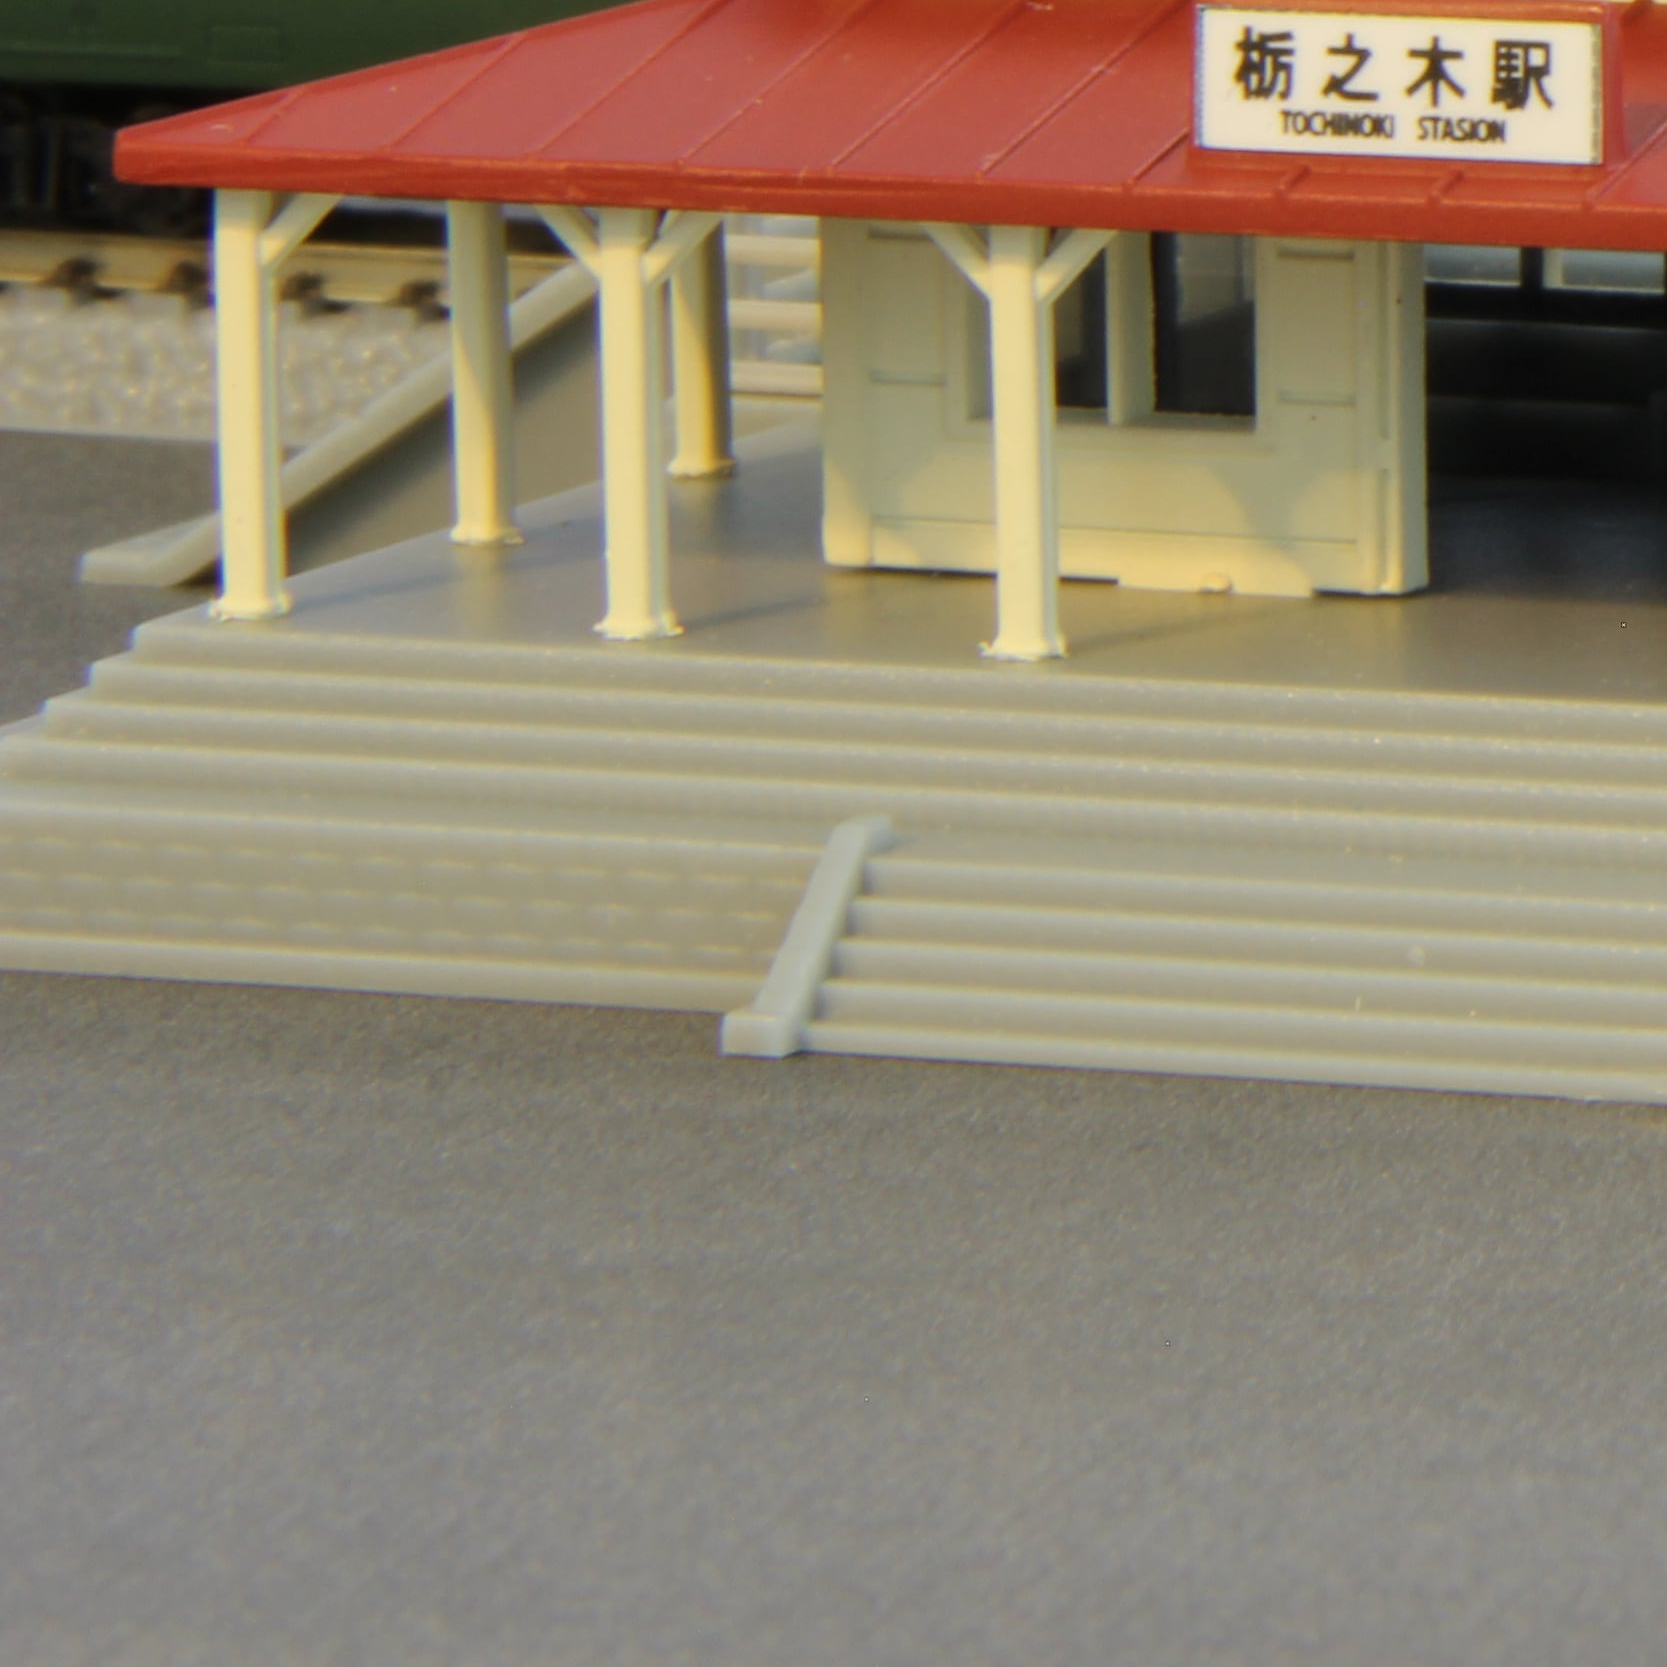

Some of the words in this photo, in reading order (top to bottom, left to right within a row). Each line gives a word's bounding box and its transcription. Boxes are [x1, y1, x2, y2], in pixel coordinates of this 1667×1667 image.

[1233, 25, 1555, 110] 栃之木駅
[1280, 110, 1395, 139] TOCHINOKI
[1416, 116, 1506, 143] STASION
